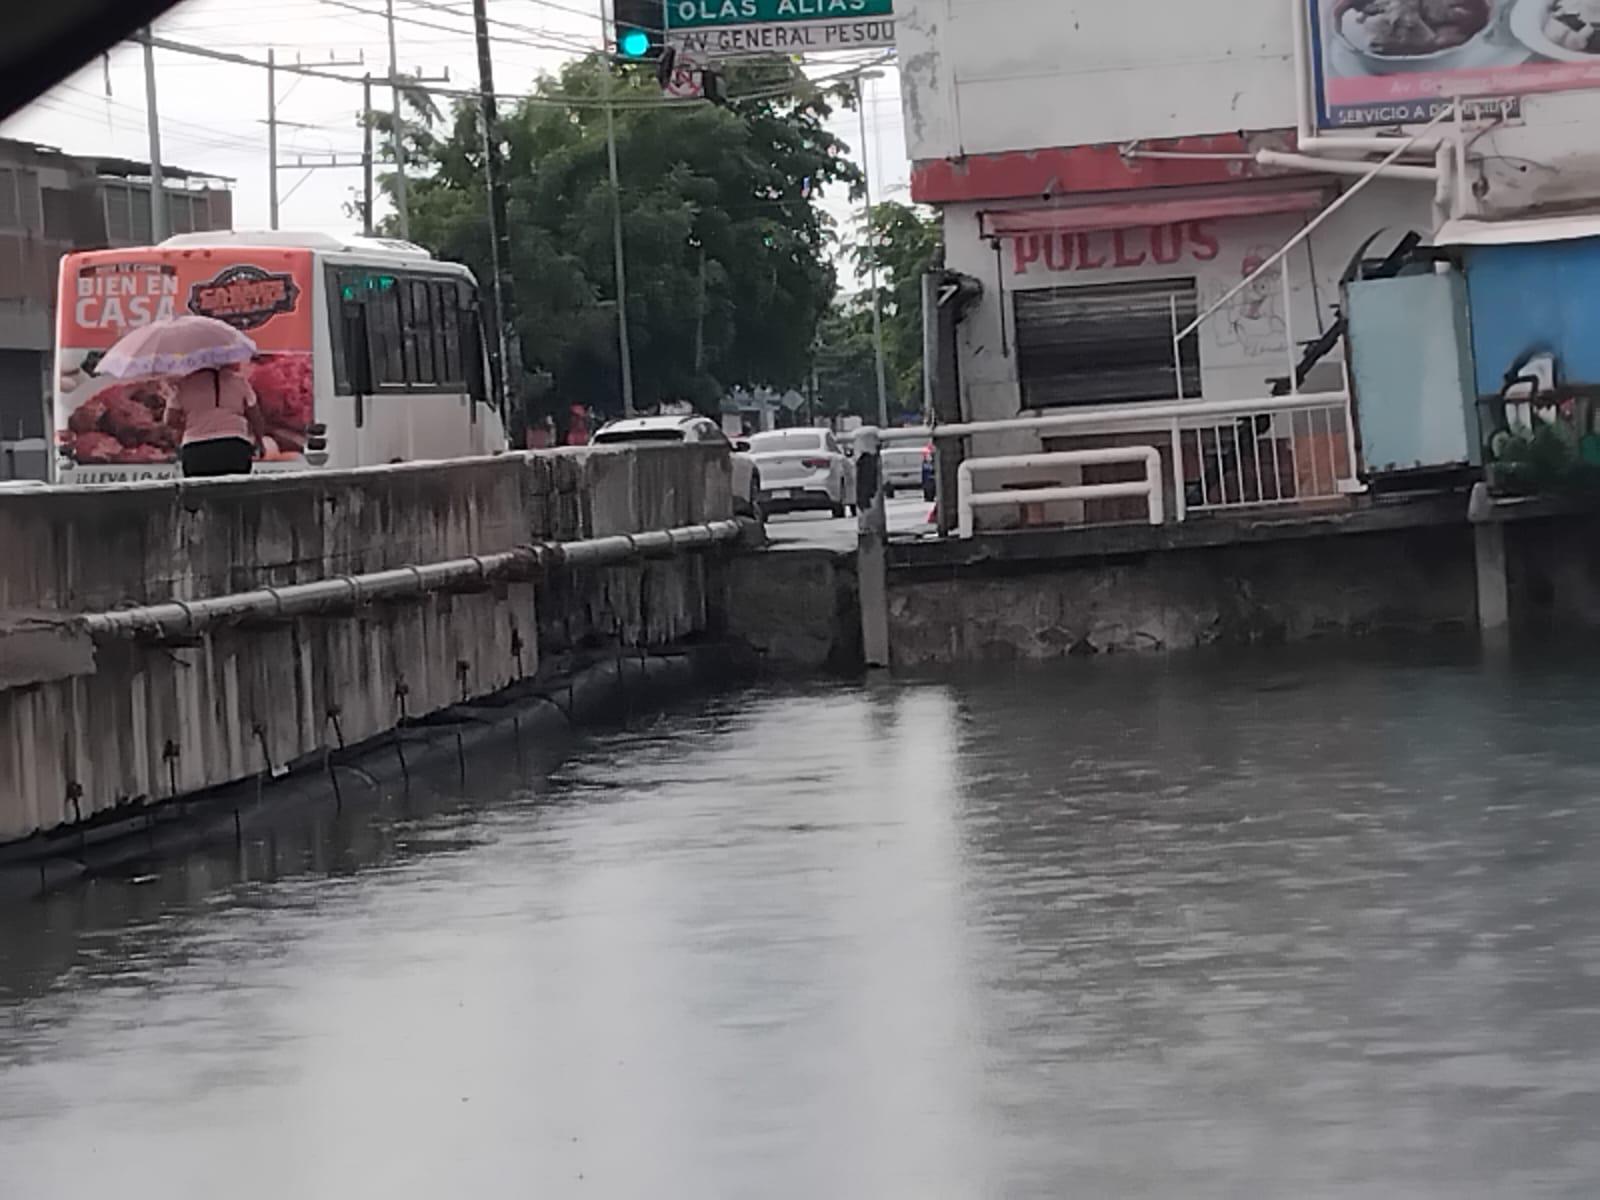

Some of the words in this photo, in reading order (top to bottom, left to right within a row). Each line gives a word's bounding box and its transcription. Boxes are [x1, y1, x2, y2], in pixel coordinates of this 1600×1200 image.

[679, 0, 757, 21] OLAS
[717, 25, 815, 50] GENERAL
[1339, 105, 1409, 123] SERVICIO
[1413, 103, 1426, 119] A
[78, 274, 137, 297] BIEN
[147, 273, 179, 295] EN
[75, 295, 176, 328] CASA
